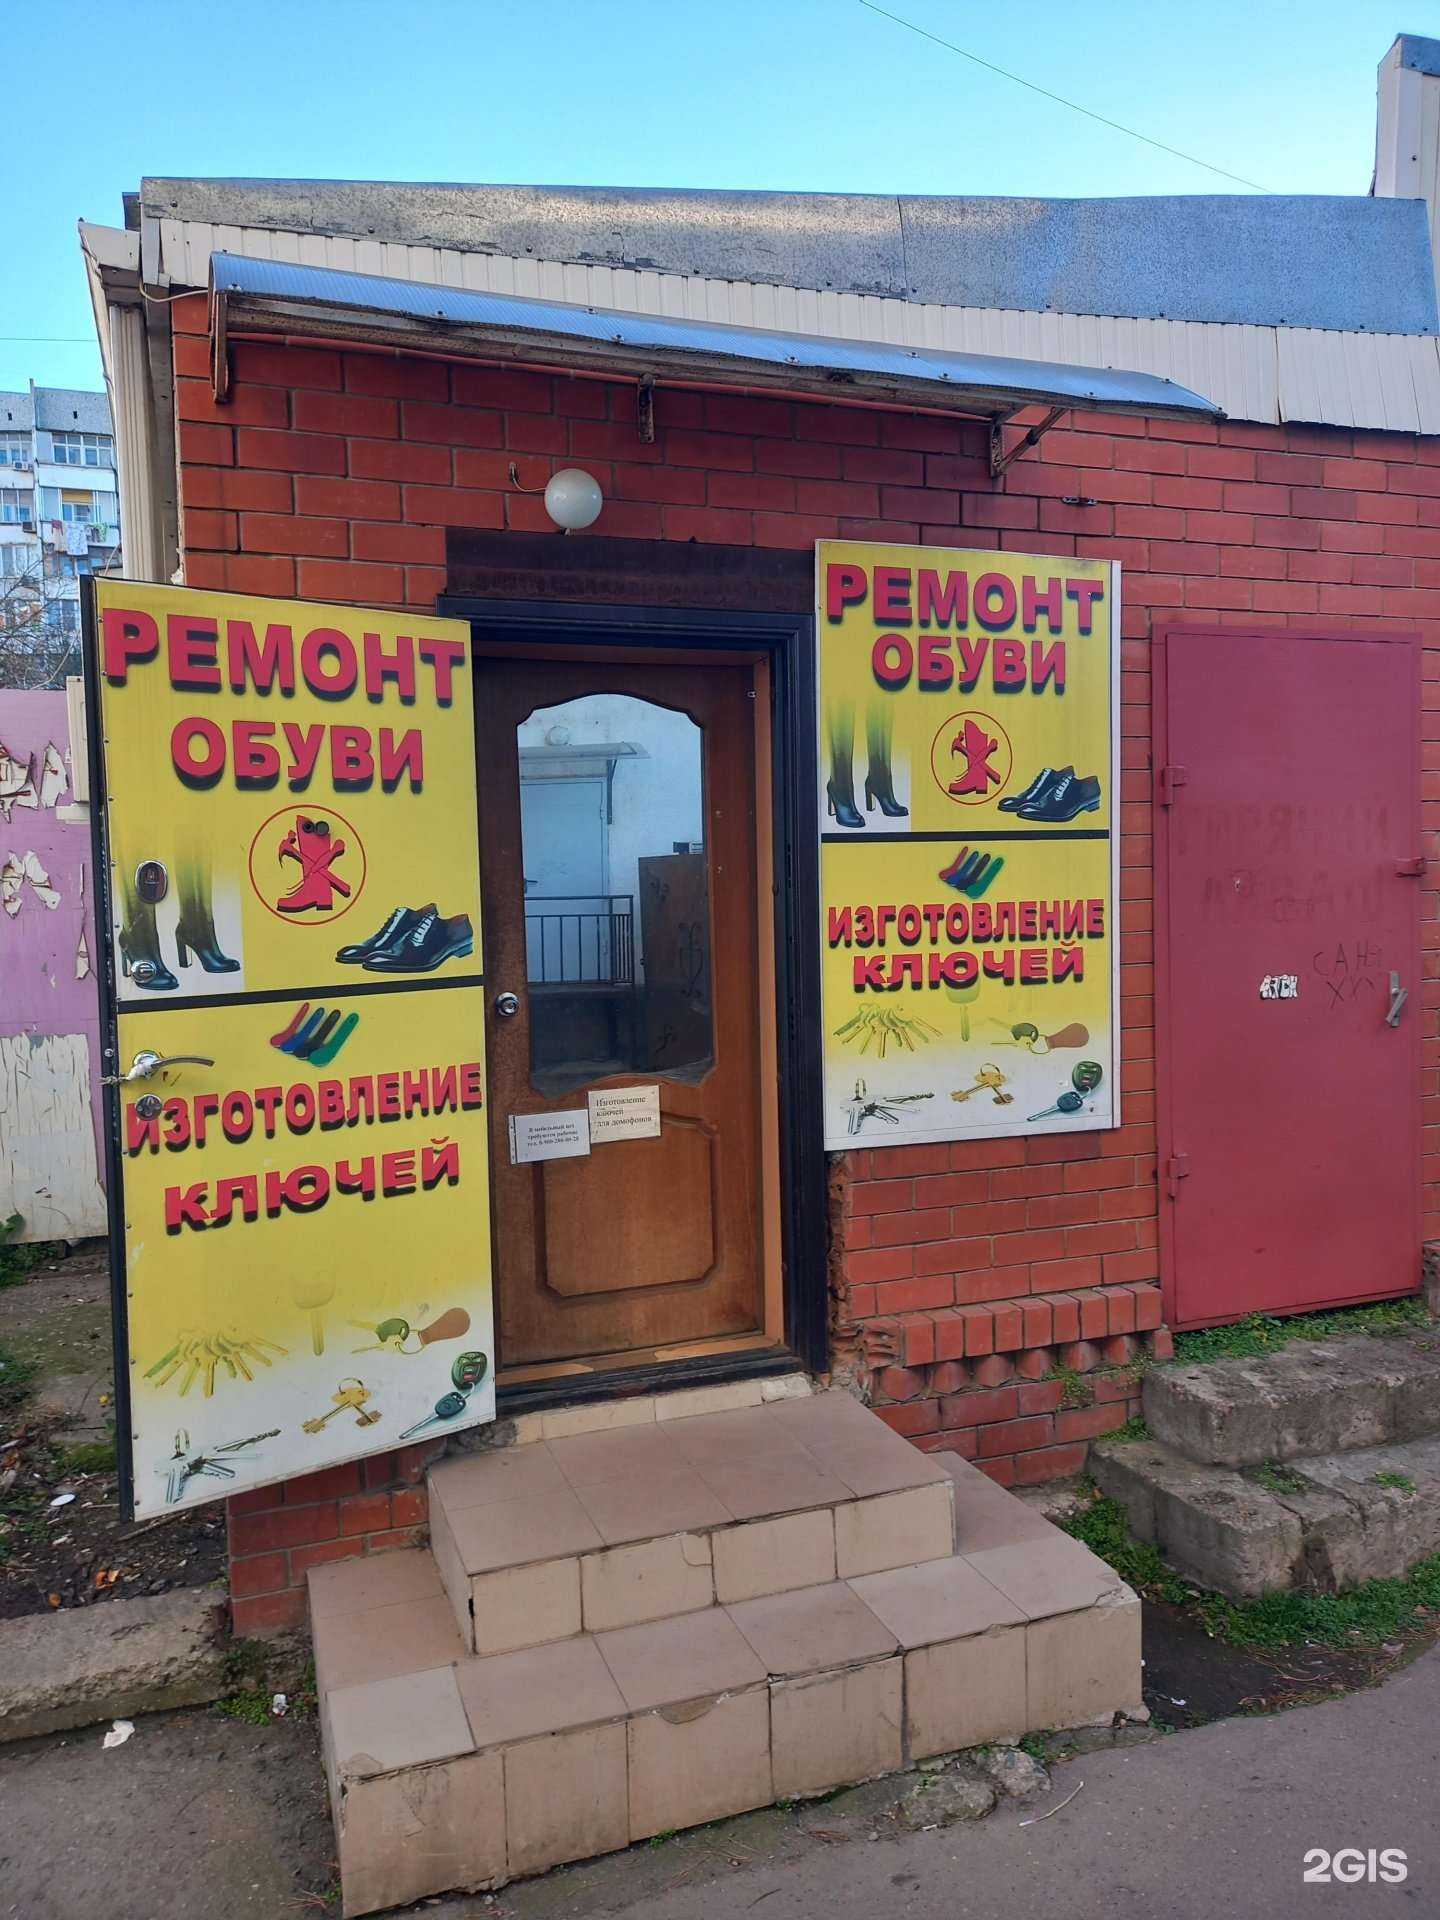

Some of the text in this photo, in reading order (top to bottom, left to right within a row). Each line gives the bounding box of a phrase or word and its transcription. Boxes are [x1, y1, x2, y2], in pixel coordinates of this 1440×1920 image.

[827, 562, 1104, 636] РЕМОНТ
[102, 607, 466, 708] РЕМОНТ
[872, 633, 1066, 696] ОБУВИ
[171, 717, 424, 794] ОБУВИ
[828, 899, 1105, 949] ИЗГОТОВЛЕНИЕ
[853, 940, 1084, 993] КЛЮЧЕЙ
[126, 1062, 483, 1157] ИЗГОТОВЛЕНИЕ
[596, 1097, 646, 1107] Изготовление
[164, 1136, 461, 1236] КЛЮЧЕЙ
